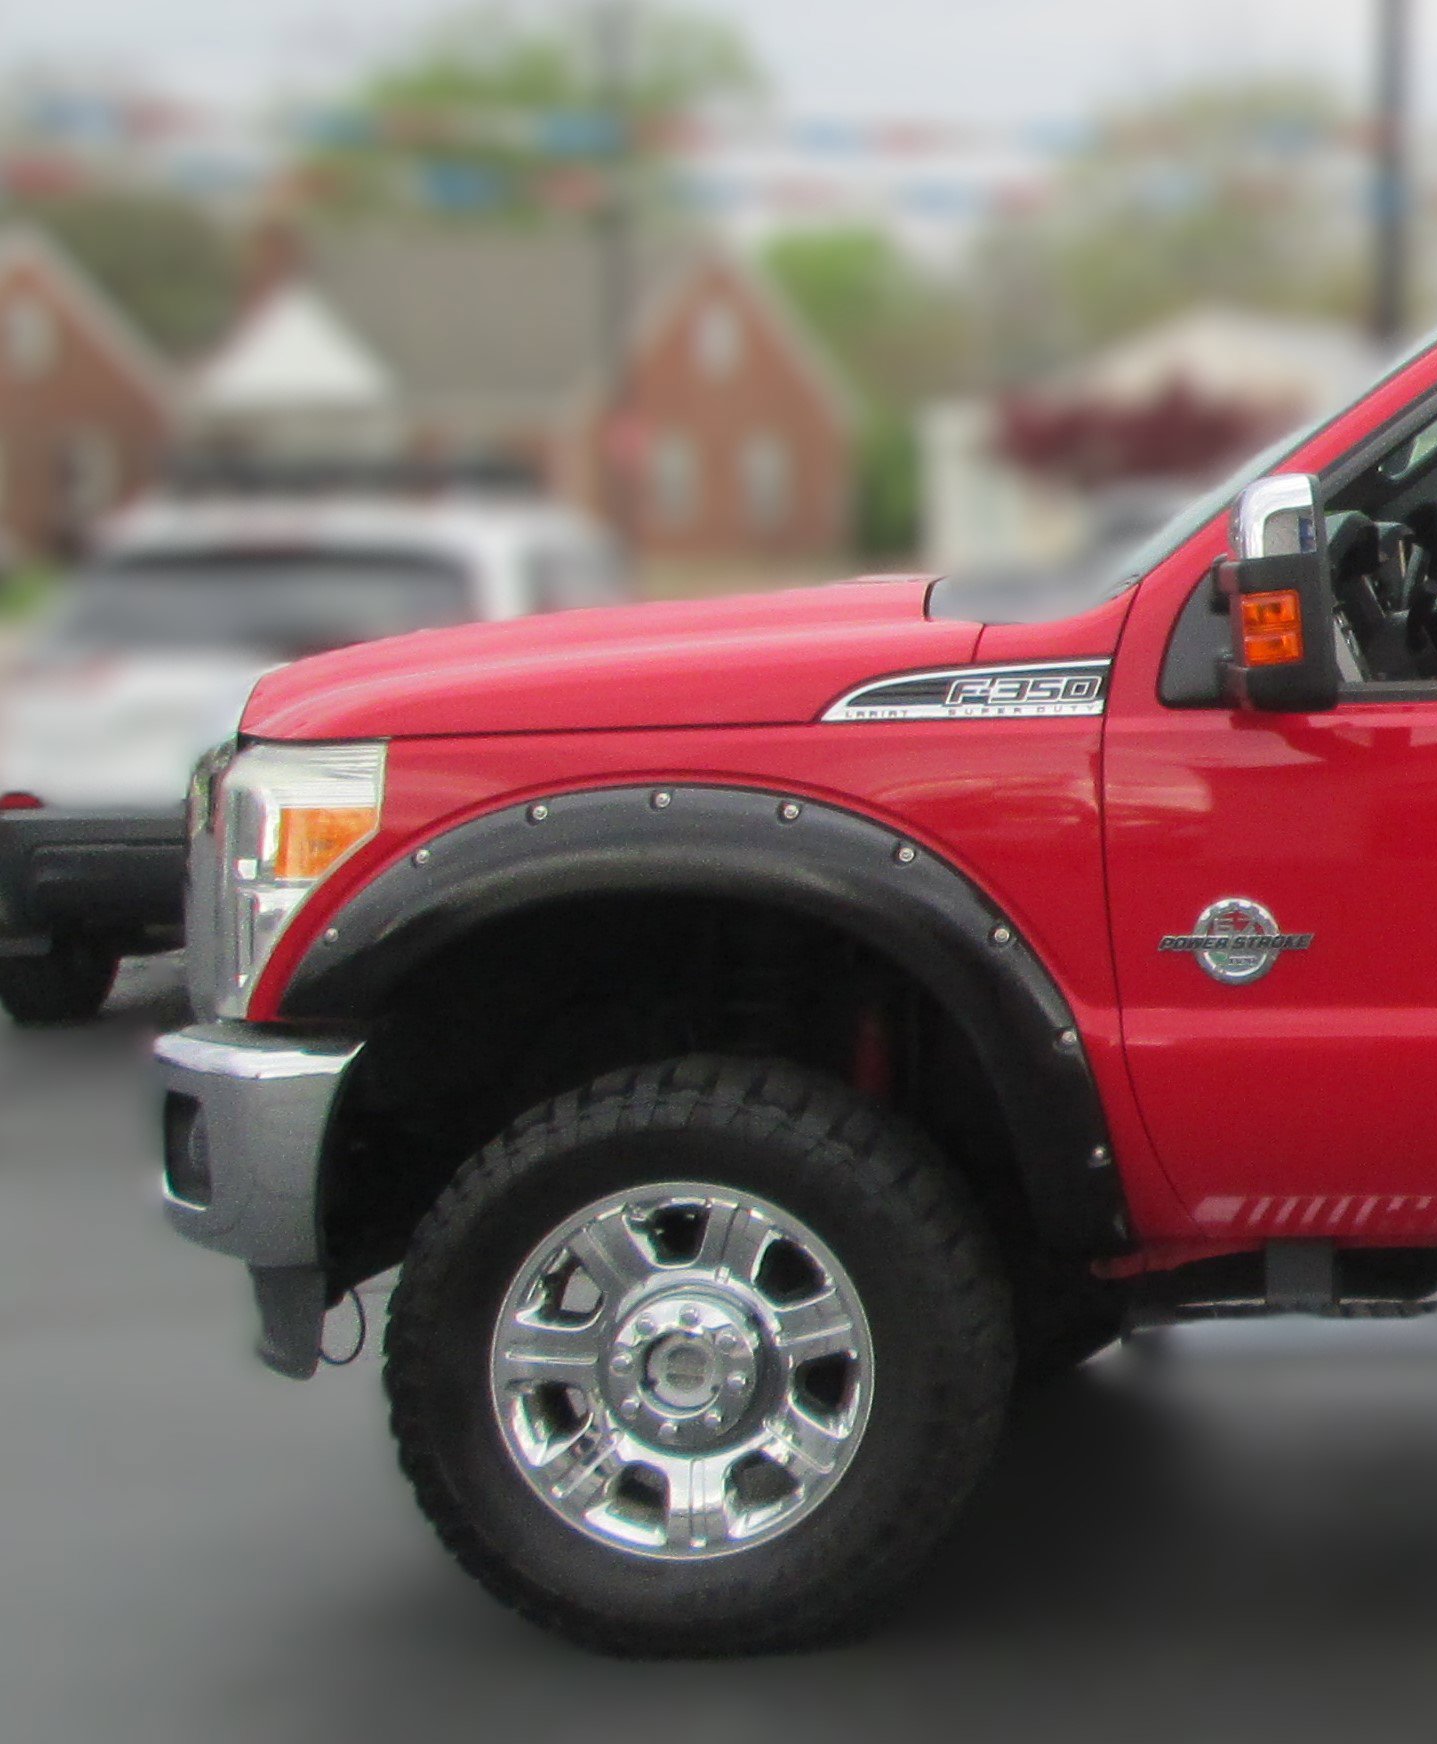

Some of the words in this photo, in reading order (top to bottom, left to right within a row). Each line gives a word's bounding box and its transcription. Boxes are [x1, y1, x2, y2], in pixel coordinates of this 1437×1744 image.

[947, 706, 1023, 716] SUPER
[1036, 704, 1096, 714] DUTY
[1159, 935, 1229, 951] POWER
[1231, 934, 1314, 950] STROKE
